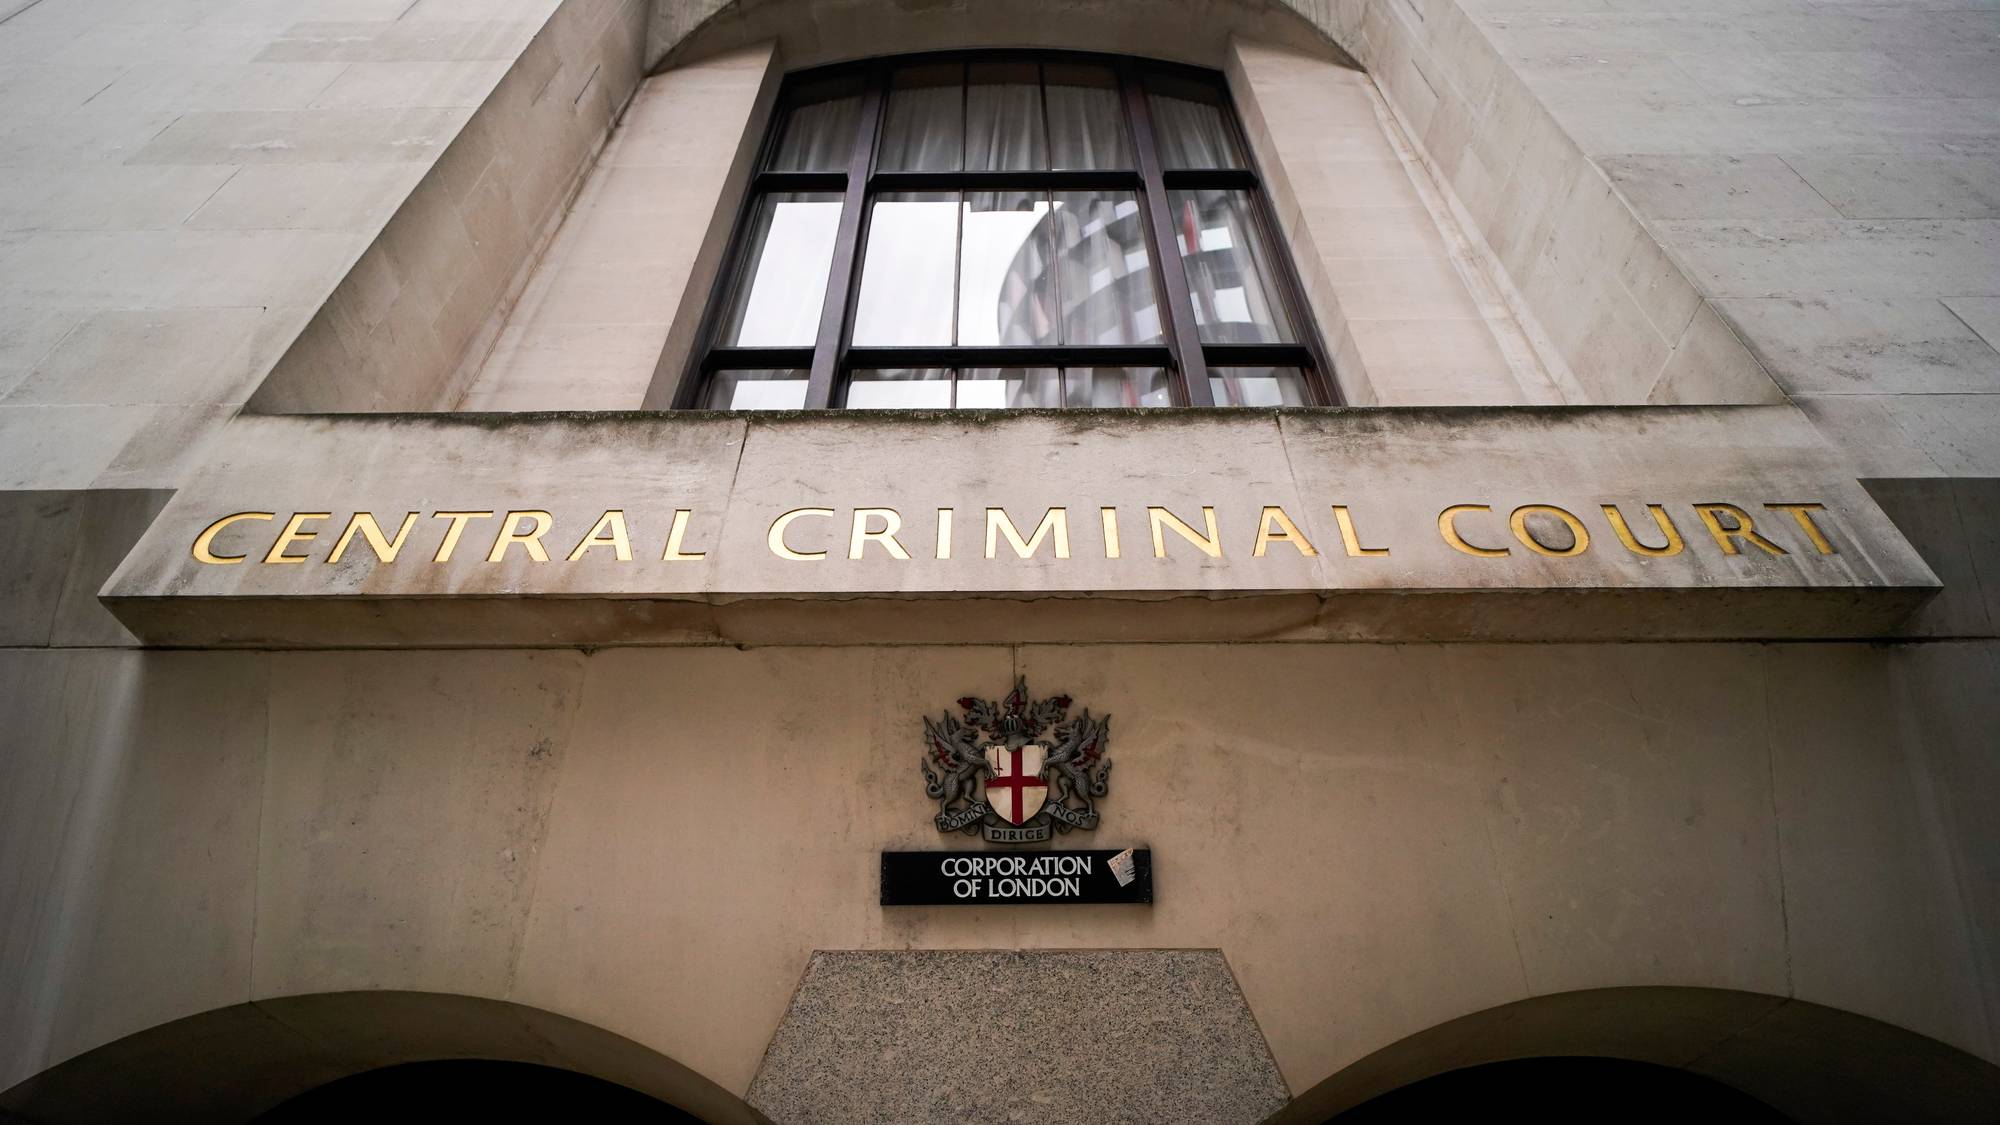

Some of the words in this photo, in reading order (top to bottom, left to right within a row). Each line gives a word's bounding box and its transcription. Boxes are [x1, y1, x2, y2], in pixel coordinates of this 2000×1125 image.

[191, 508, 707, 565] CENTRAL
[767, 504, 1390, 560] CRIMINAL
[1437, 503, 1839, 558] COURT
[991, 829, 1044, 840] DIRIGE
[1053, 805, 1085, 826] NOS
[941, 856, 1092, 876] CORPORATION
[953, 878, 982, 898] OF
[988, 877, 1080, 897] LONDON
